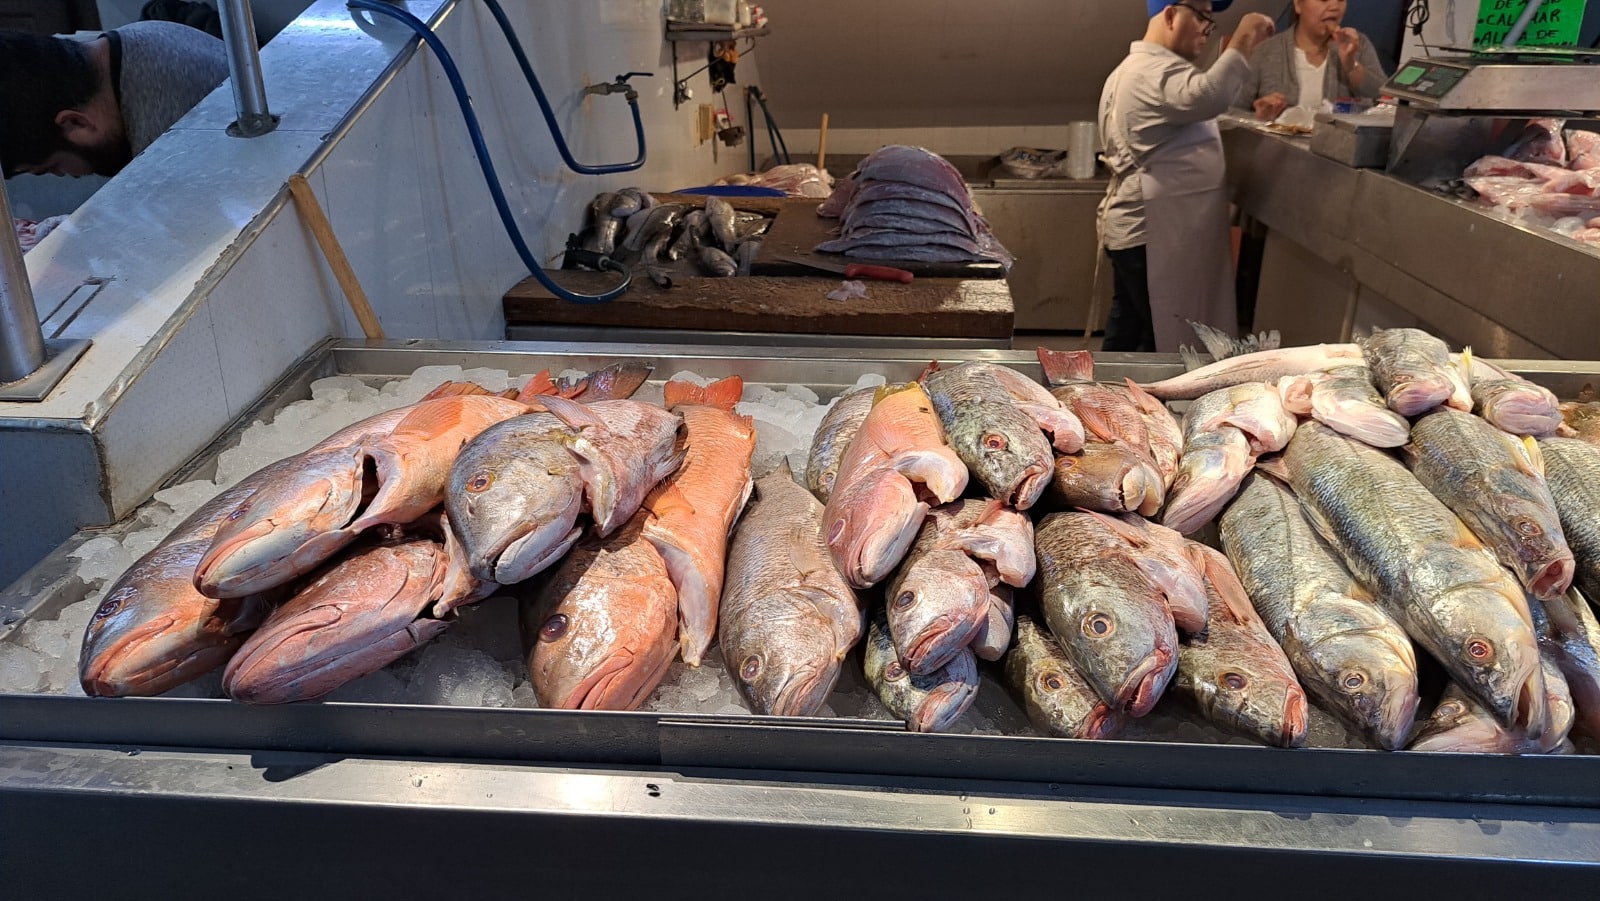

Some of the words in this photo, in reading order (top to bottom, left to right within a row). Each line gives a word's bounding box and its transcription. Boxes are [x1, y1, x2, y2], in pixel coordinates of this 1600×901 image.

[1486, 8, 1561, 26] CALMAR
[1480, 31, 1528, 45] ALA
[1536, 29, 1559, 40] DE
